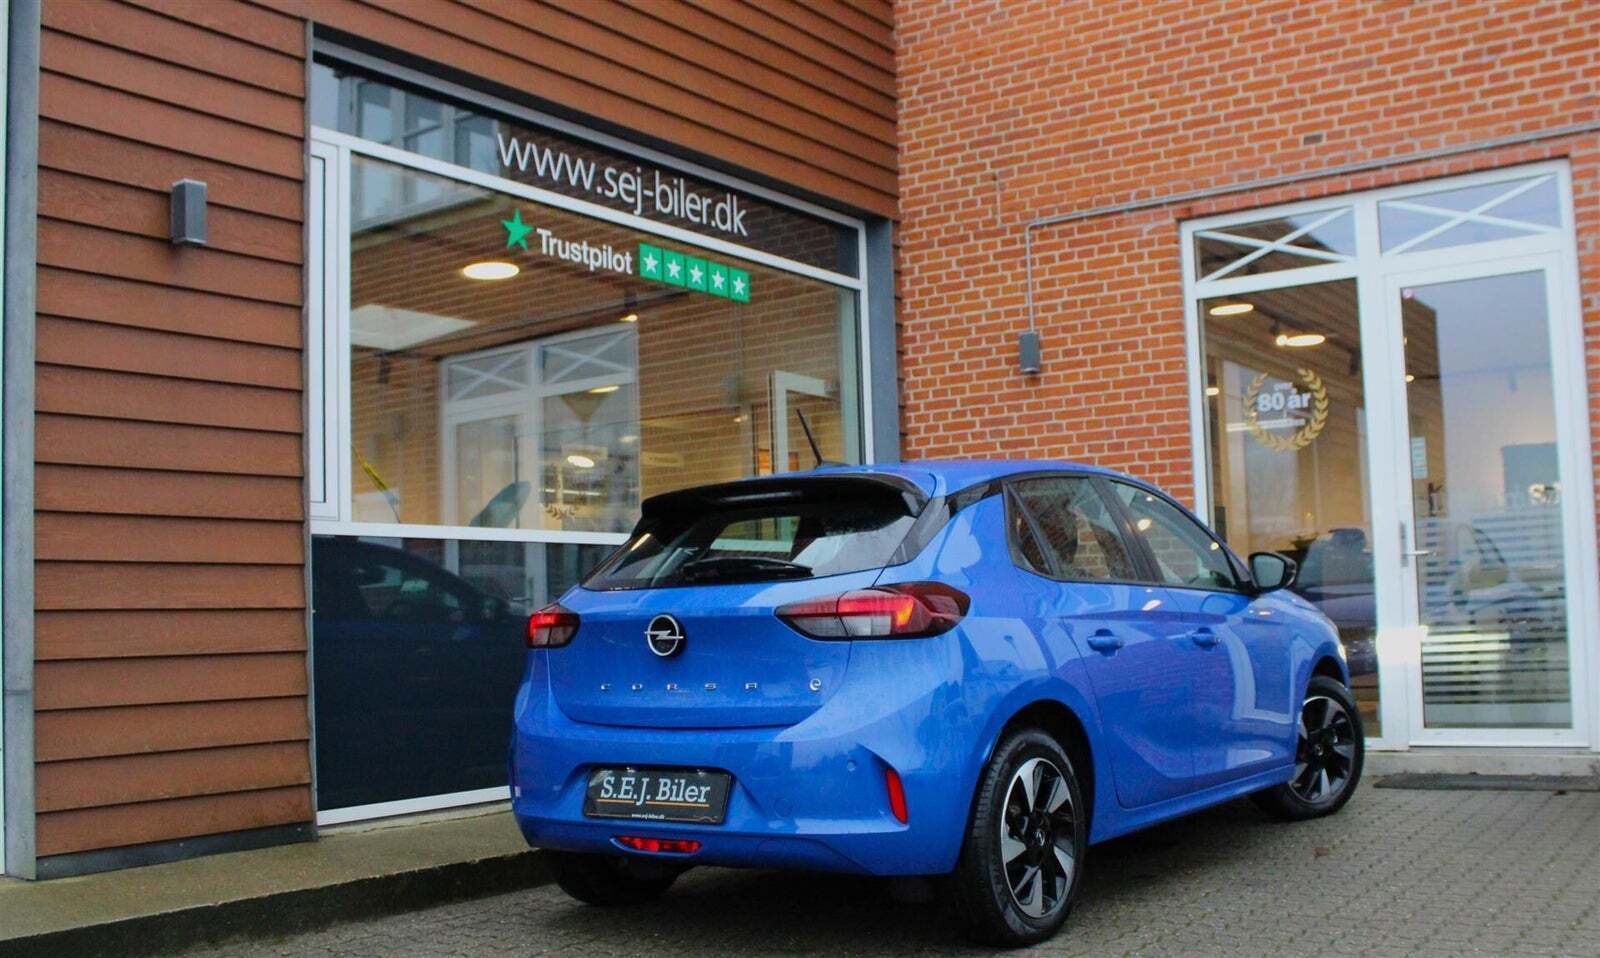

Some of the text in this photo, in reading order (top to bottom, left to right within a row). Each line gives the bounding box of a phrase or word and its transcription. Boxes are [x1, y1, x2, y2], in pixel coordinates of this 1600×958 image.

[498, 133, 748, 236] www.sej-biler.dk
[536, 228, 633, 275] Trustpilot
[1257, 392, 1285, 412] 80
[601, 683, 757, 691] CORSA
[601, 777, 710, 805] S.E.J. Biler
